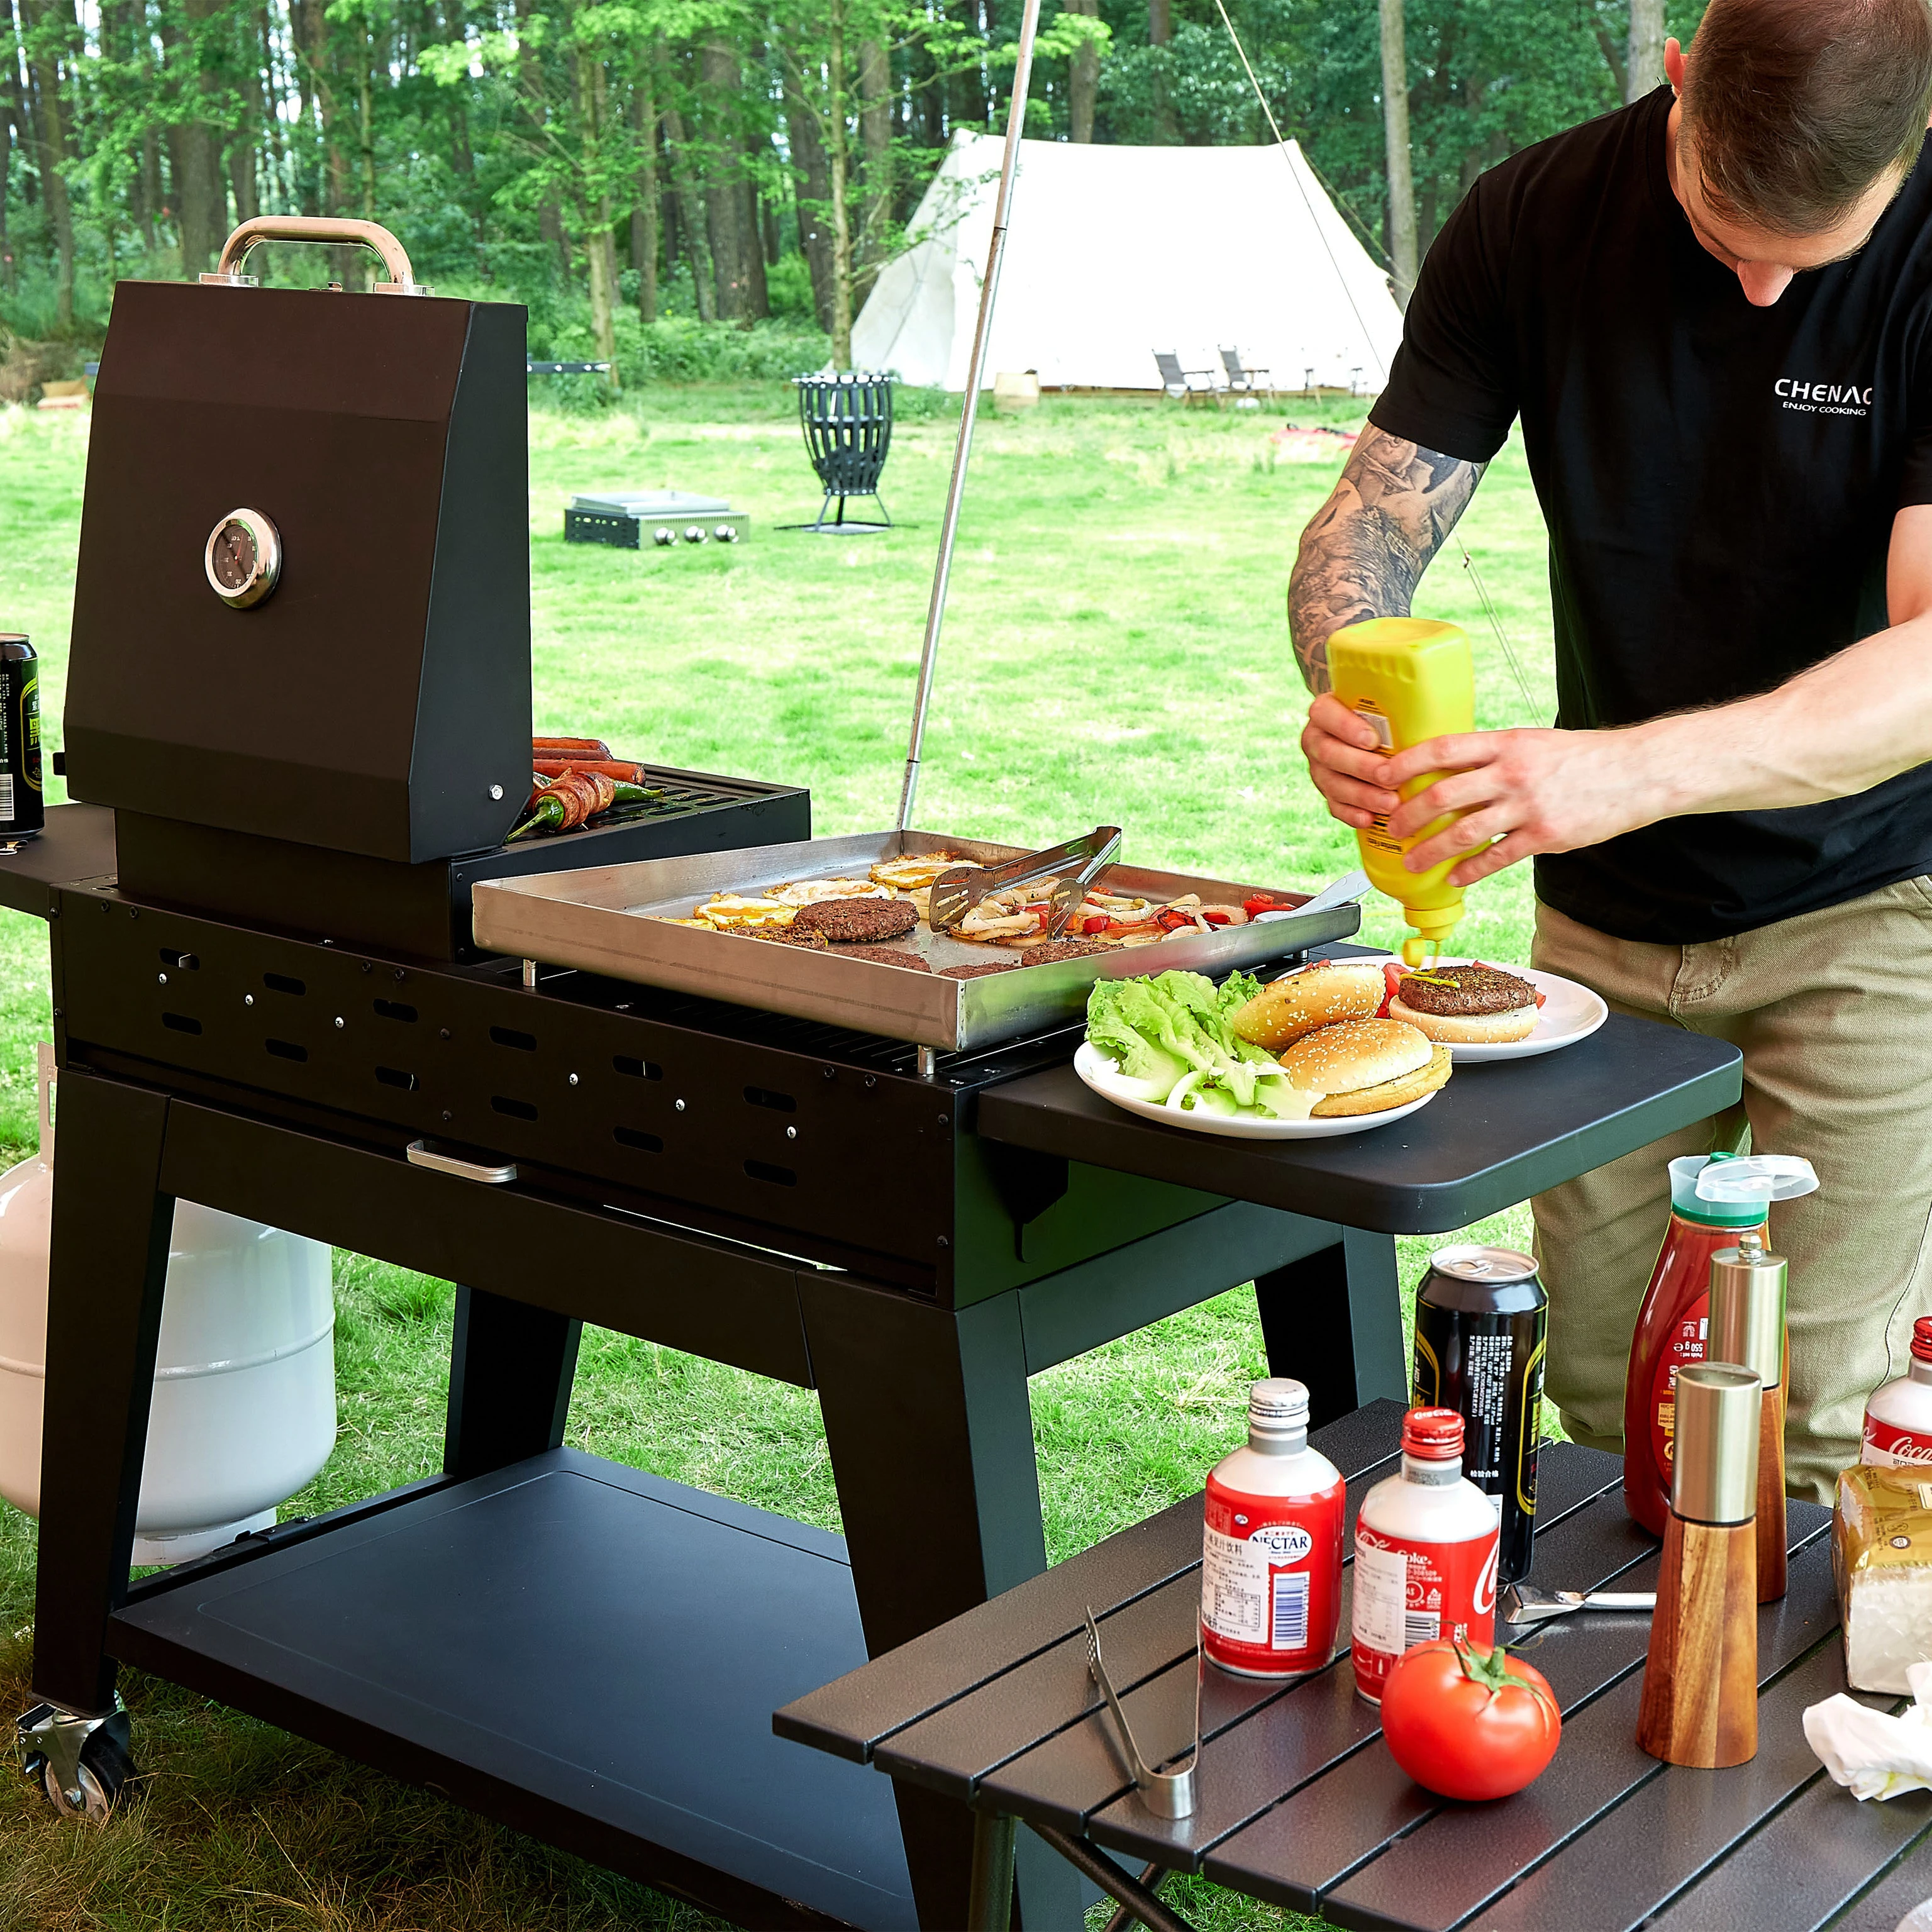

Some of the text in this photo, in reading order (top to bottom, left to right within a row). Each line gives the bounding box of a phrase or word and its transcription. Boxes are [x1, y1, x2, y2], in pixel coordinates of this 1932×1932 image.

[1782, 401, 1867, 416] ENJOY COOKING
[1684, 1341, 1690, 1350] g
[1690, 1343, 1703, 1352] 550
[1252, 1536, 1308, 1550] NECTAR
